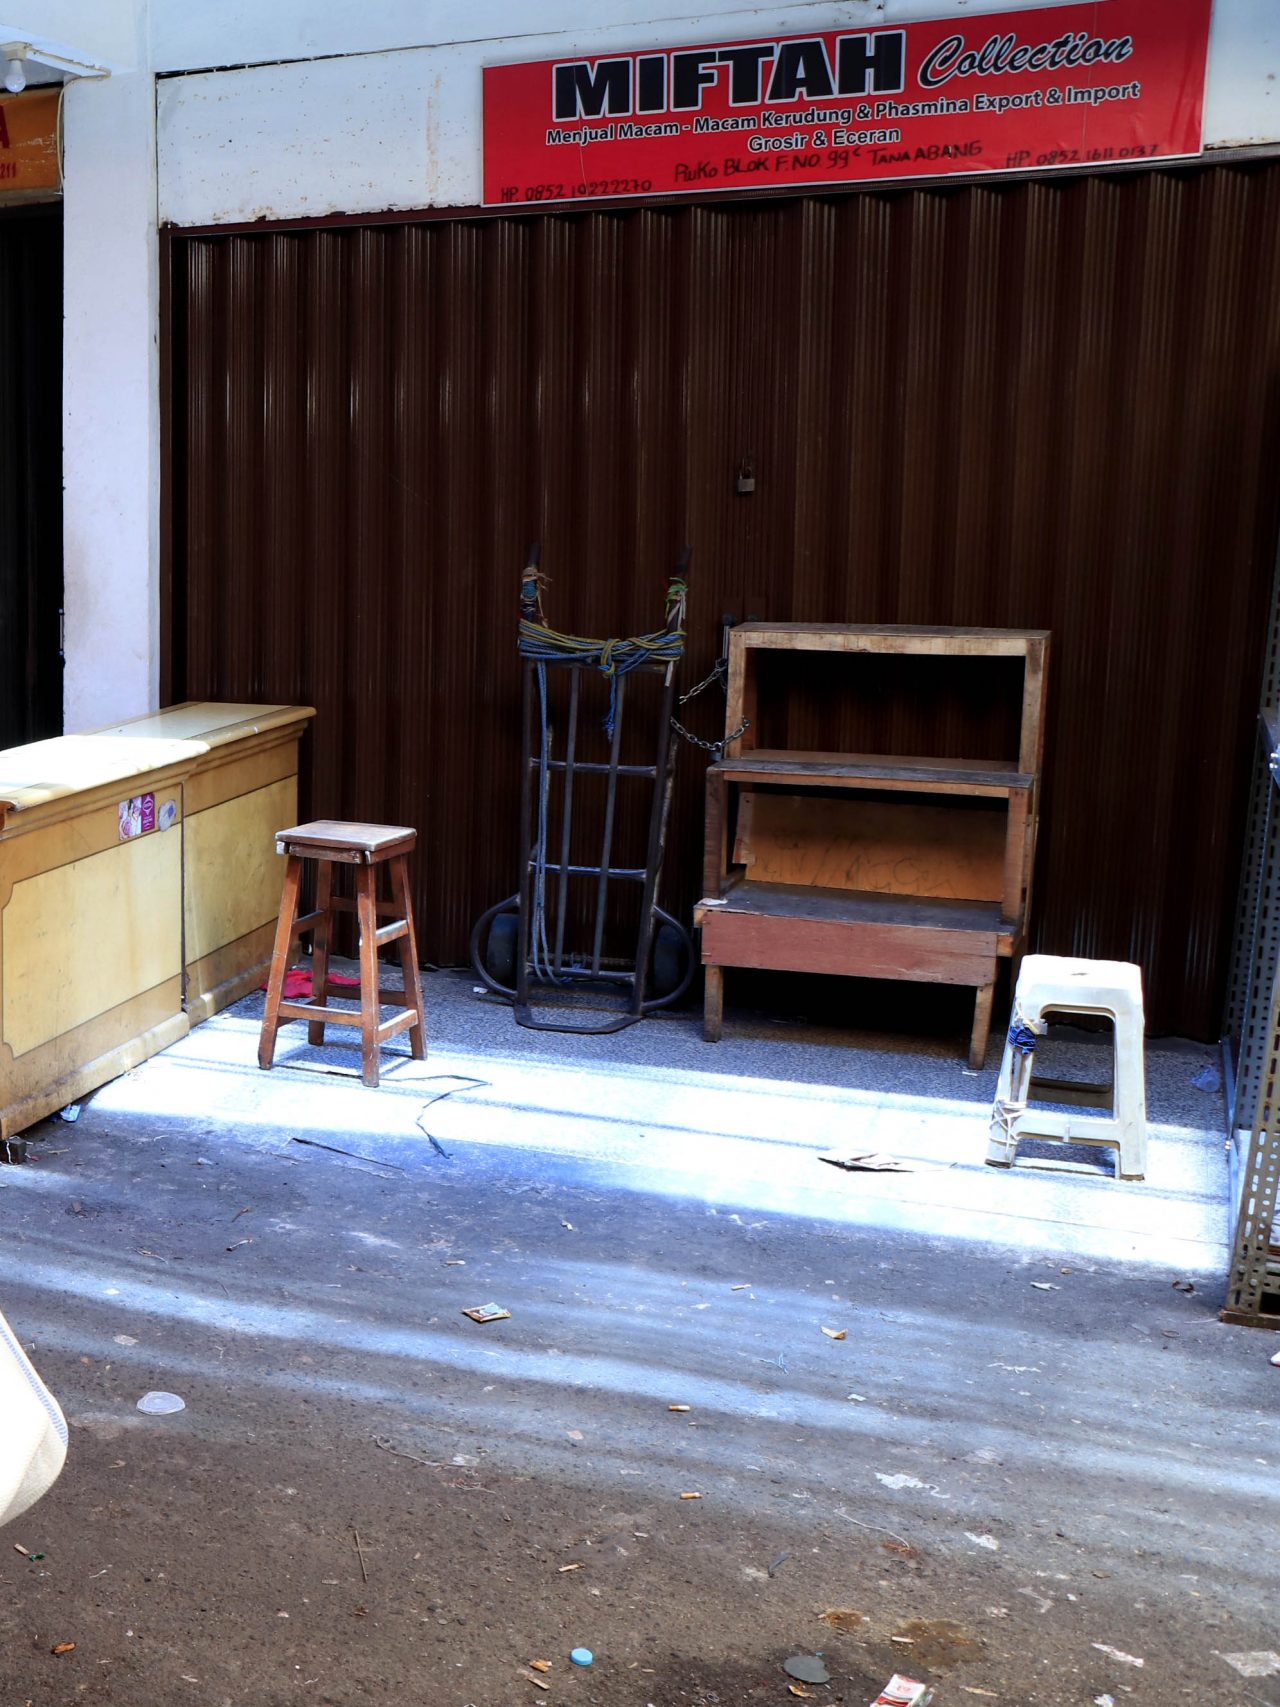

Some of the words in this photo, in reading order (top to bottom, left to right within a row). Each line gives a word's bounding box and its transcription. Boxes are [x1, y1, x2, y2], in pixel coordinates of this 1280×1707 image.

[552, 31, 906, 122] MIFTAH
[918, 32, 1133, 88] Collection
[546, 128, 614, 146] Menjual
[618, 122, 679, 139] Macam
[694, 115, 756, 133] Macam
[761, 106, 852, 129] Kerudung
[856, 104, 872, 121] &
[875, 98, 969, 120] Phasmina
[974, 91, 1041, 113] Export
[1045, 88, 1062, 105] &
[1066, 82, 1140, 104] Import
[748, 132, 808, 152] Grosir
[812, 131, 827, 147] &
[833, 128, 901, 146] Eceran
[914, 140, 983, 163] ABANG
[1036, 149, 1081, 166] 0852
[525, 184, 565, 201] 0852
